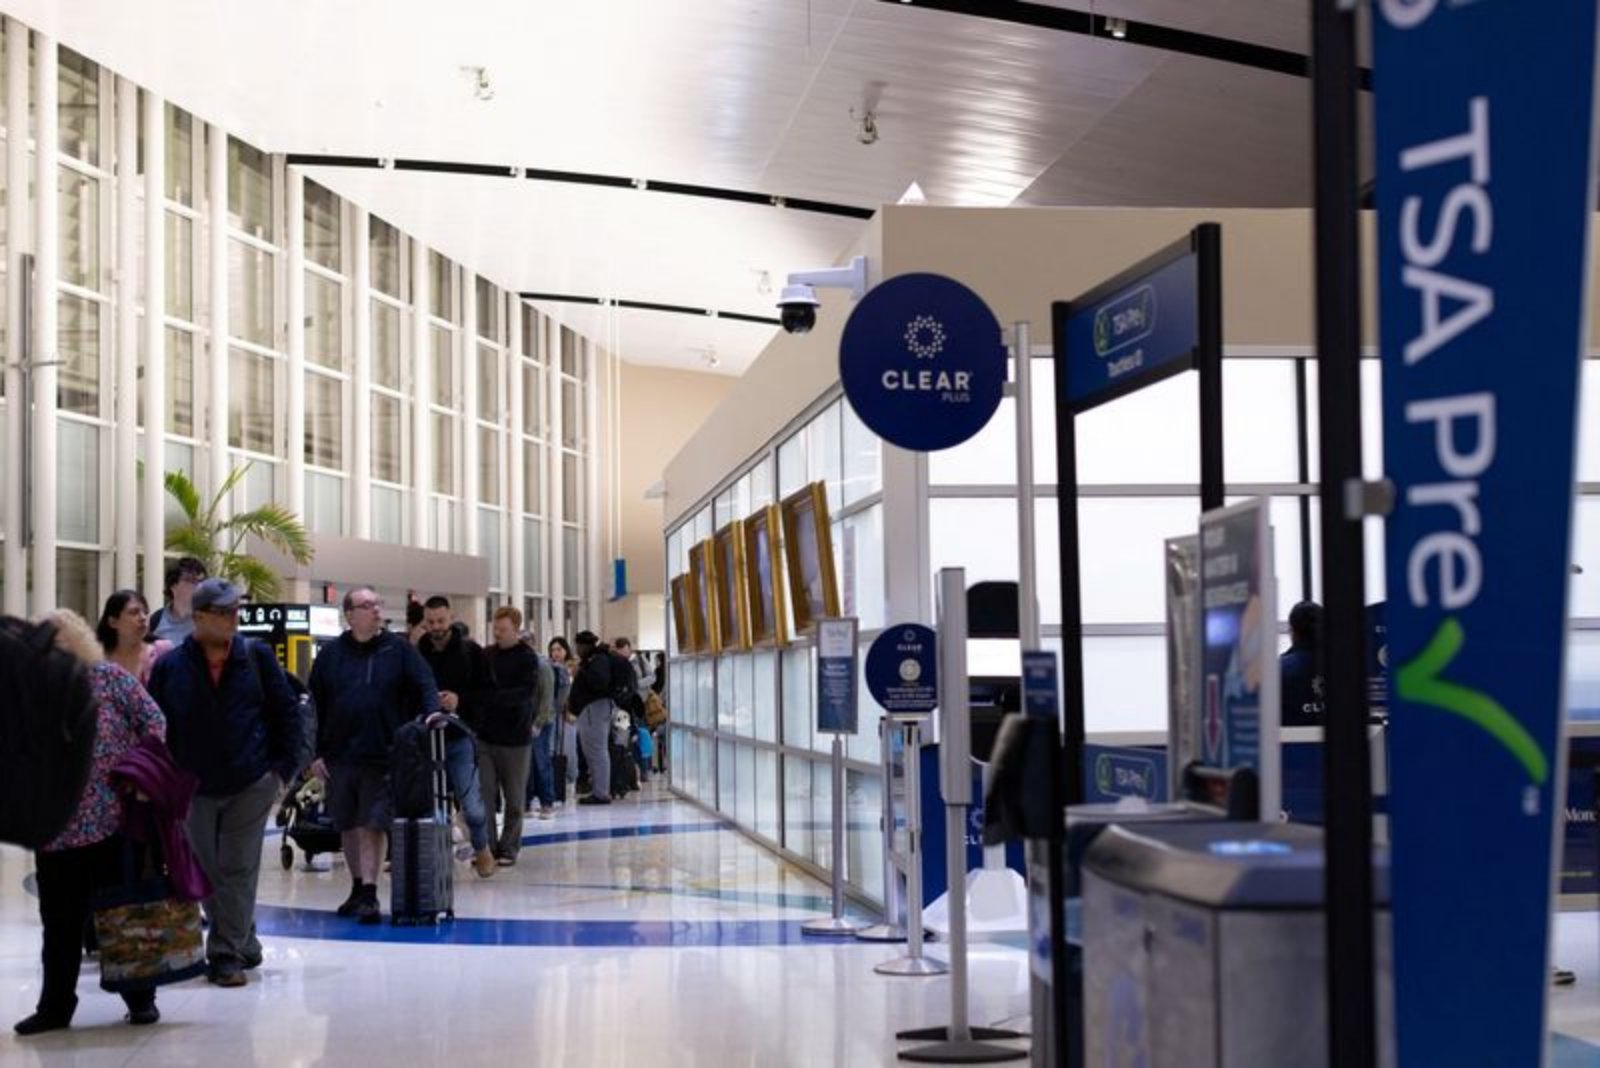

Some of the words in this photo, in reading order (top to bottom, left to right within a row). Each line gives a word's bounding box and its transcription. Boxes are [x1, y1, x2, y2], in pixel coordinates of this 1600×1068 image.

[1400, 97, 1493, 365] TSA
[881, 369, 970, 391] CLEAR
[941, 391, 970, 402] PLUS
[1405, 391, 1496, 609] Pre
[1302, 702, 1325, 713] CL
